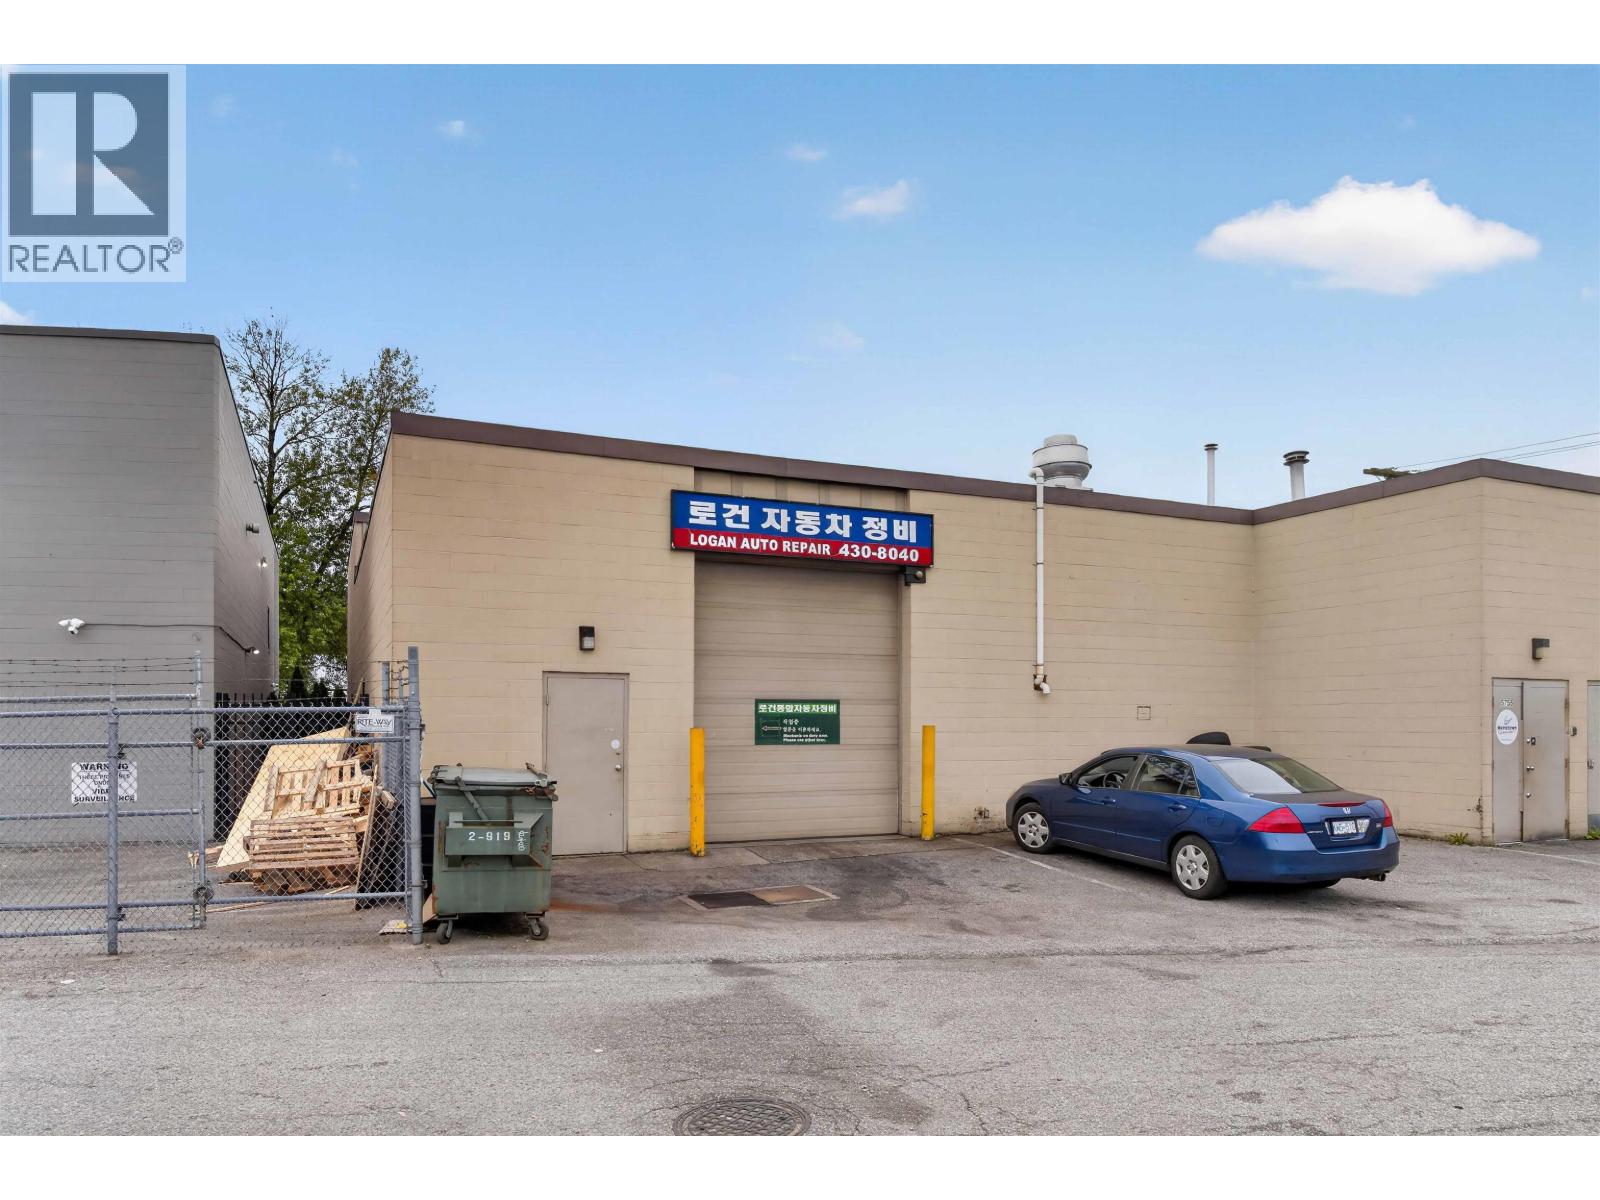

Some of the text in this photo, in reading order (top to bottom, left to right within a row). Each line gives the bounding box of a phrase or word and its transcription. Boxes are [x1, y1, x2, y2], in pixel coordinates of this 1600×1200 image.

[688, 500, 917, 543] 로건 자동차 정비
[690, 533, 919, 562] LOGAN AUTO REPAIR 430-8040
[468, 831, 511, 841] 2-919
